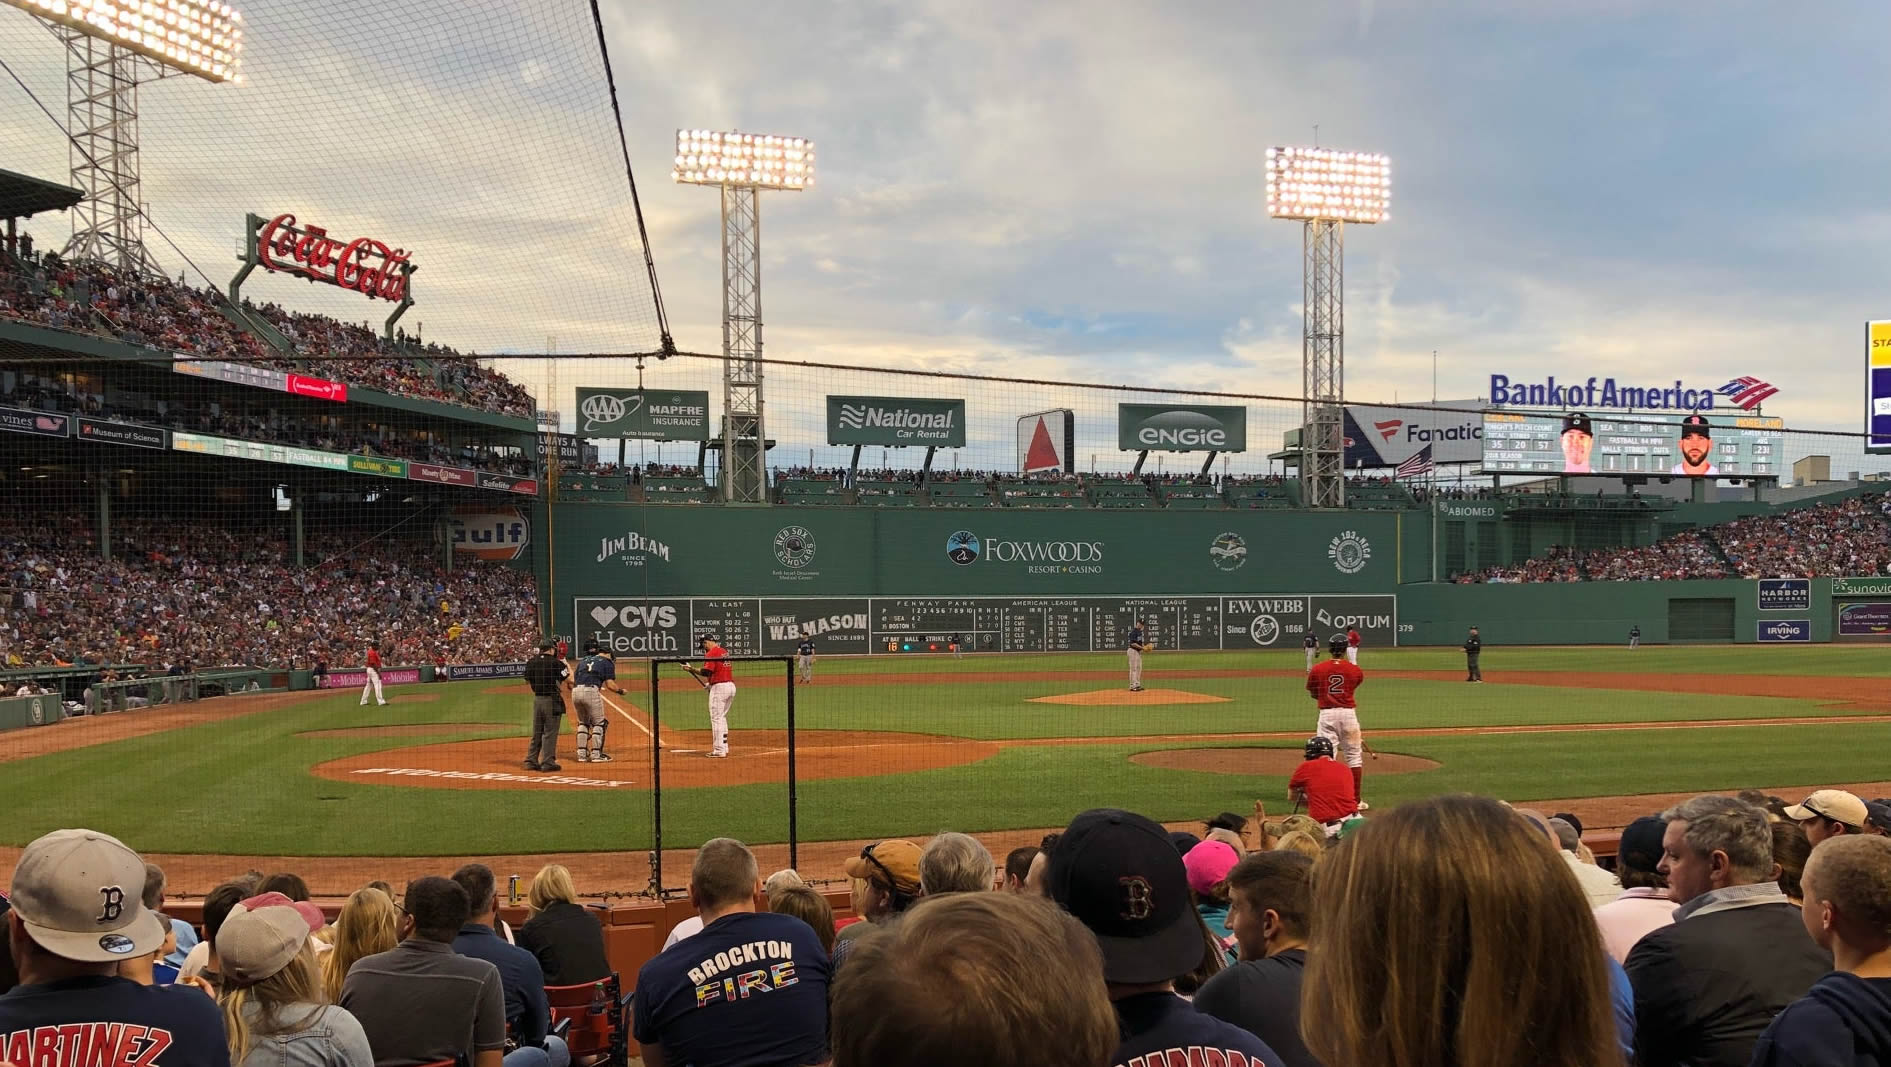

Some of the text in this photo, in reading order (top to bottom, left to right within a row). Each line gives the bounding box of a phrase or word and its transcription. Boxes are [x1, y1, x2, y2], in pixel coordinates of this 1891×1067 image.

[258, 213, 412, 303] Coca-Cola
[1490, 374, 1714, 411] Bank of America
[587, 395, 621, 421] AAA
[650, 405, 704, 416] MAPFRE
[2, 414, 33, 427] vines
[652, 417, 701, 426] INSURANCE
[866, 407, 951, 429] National
[93, 427, 122, 438] Museum
[133, 433, 160, 443] Science
[571, 438, 577, 448] A
[896, 430, 950, 440] Car Rental
[1722, 445, 1736, 454] 103
[482, 479, 510, 490] Safelite
[1448, 508, 1494, 516] ABIOMED
[776, 528, 808, 546] RED SOX
[596, 532, 670, 562] JIM BEAM
[777, 543, 814, 566] SCHOLARS
[984, 538, 1102, 562] FOXWOODS
[1028, 566, 1102, 574] RESORT CASINO
[1228, 600, 1304, 614] F.W. WEBB
[620, 606, 677, 628] CVS
[764, 616, 796, 624] WHO BUT
[1334, 615, 1390, 628] OPTUM
[802, 614, 868, 637] MASON
[1226, 624, 1246, 634] Since
[1285, 624, 1304, 633] 1866
[1768, 626, 1800, 634] IRVING
[594, 630, 678, 652] Health
[390, 671, 415, 684] Mobile
[453, 665, 514, 676] SAMUEL ADAMS SAMUEL
[1328, 674, 1344, 694] 2
[96, 886, 126, 924] B
[1120, 875, 1154, 920] B
[688, 940, 793, 986] BROCKTON
[696, 961, 800, 1008] FIRE
